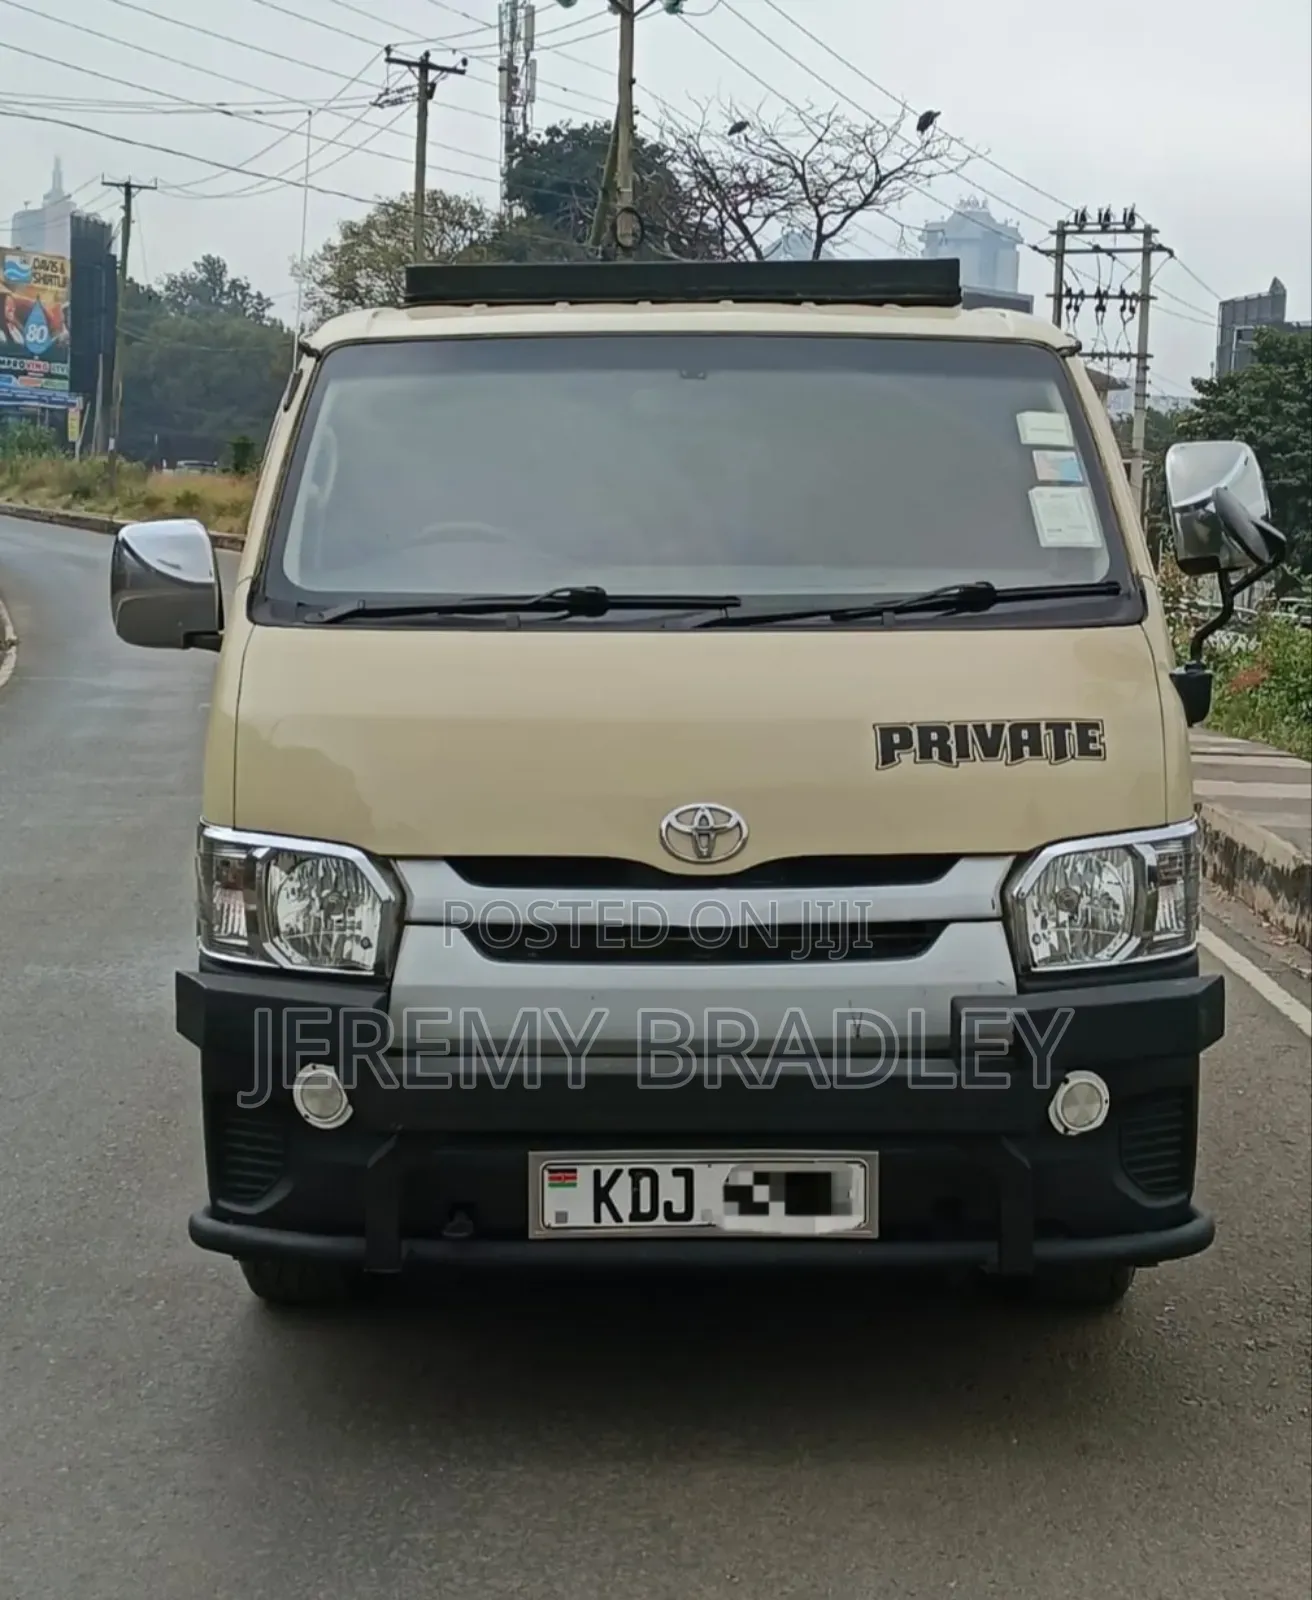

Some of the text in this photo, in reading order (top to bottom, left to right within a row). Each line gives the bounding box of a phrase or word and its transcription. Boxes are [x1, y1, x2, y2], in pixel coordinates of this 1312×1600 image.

[26, 323, 49, 344] 80
[873, 719, 1106, 770] PRIVATE
[593, 1167, 695, 1224] KDJ
